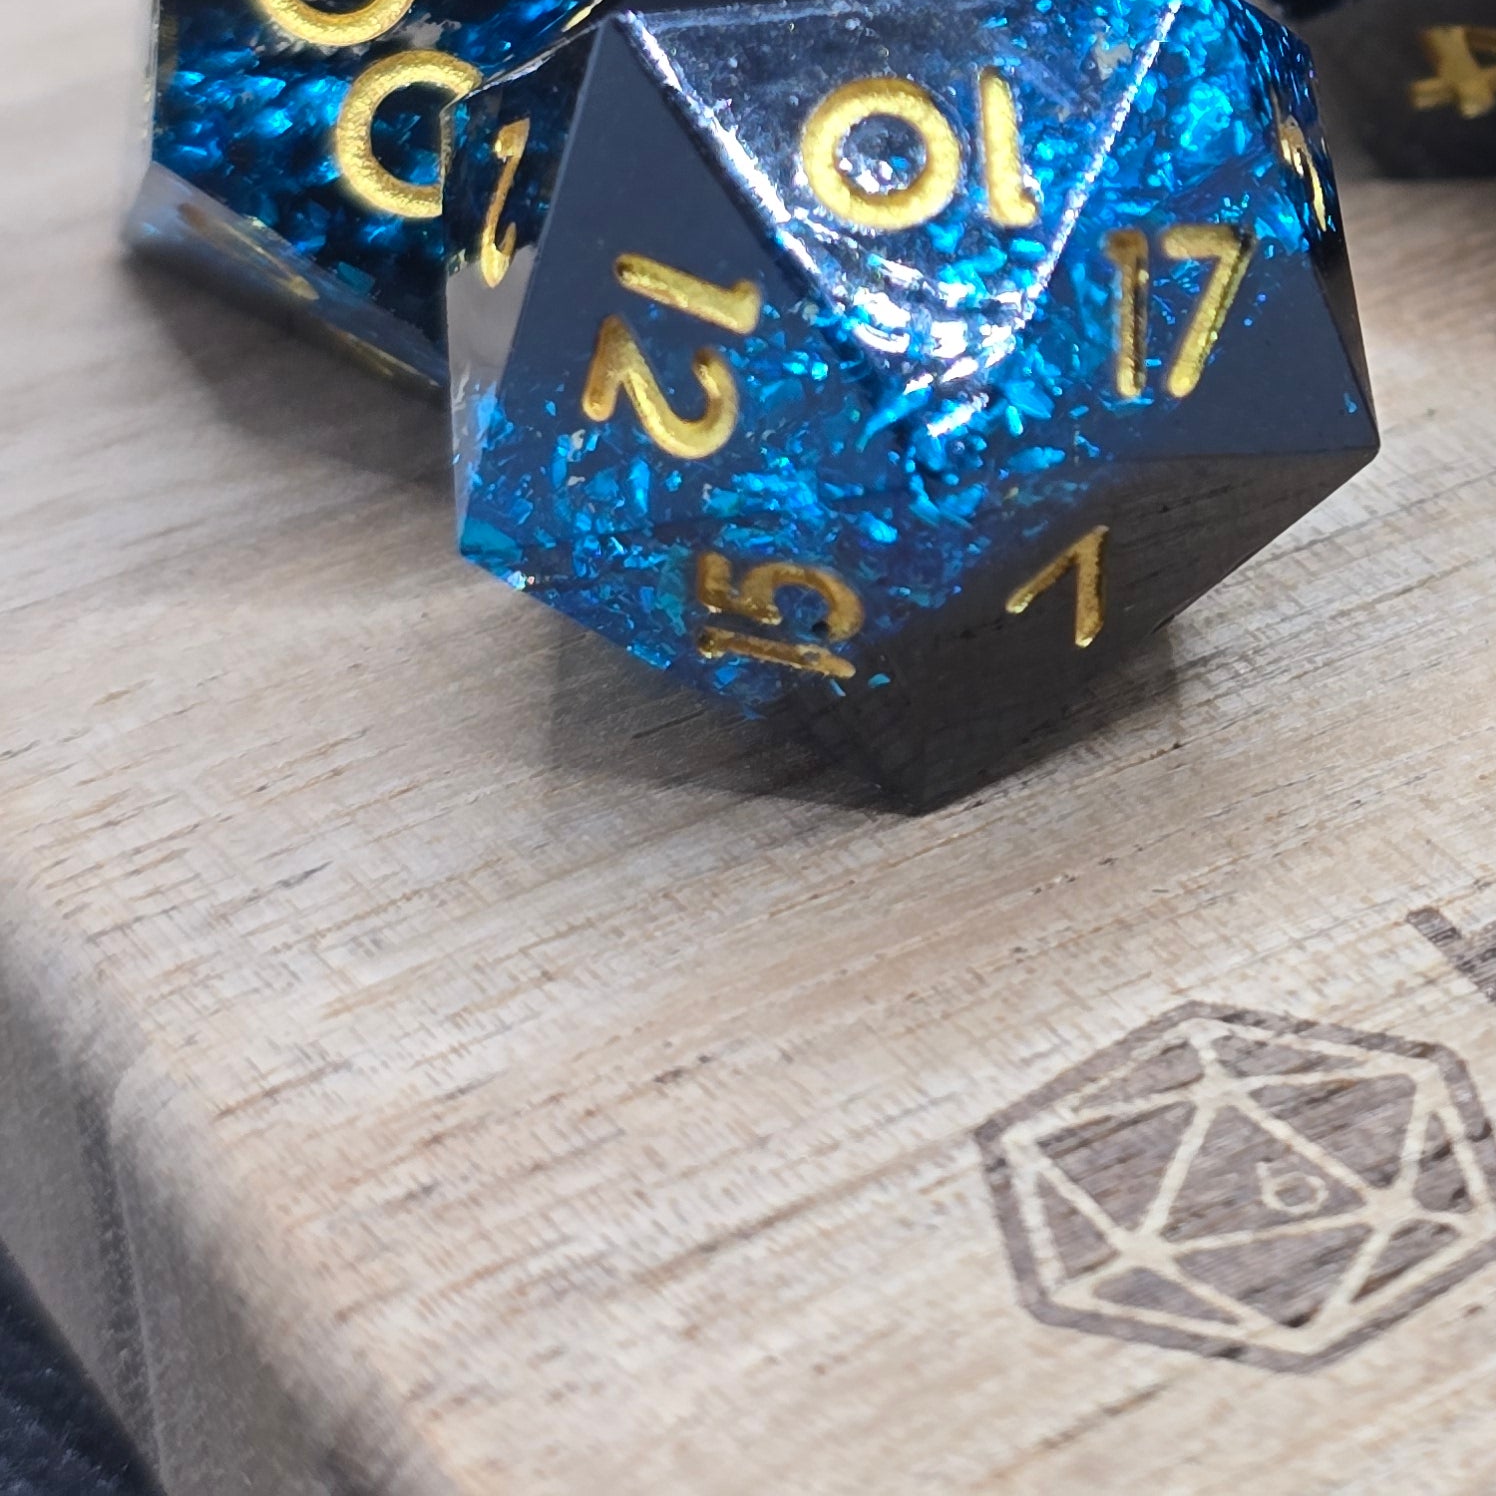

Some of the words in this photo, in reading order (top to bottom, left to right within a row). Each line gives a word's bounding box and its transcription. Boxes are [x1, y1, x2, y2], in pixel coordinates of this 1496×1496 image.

[802, 66, 1041, 232] 10
[581, 250, 763, 459] 12
[1101, 223, 1259, 400] 17
[696, 550, 866, 680] 15
